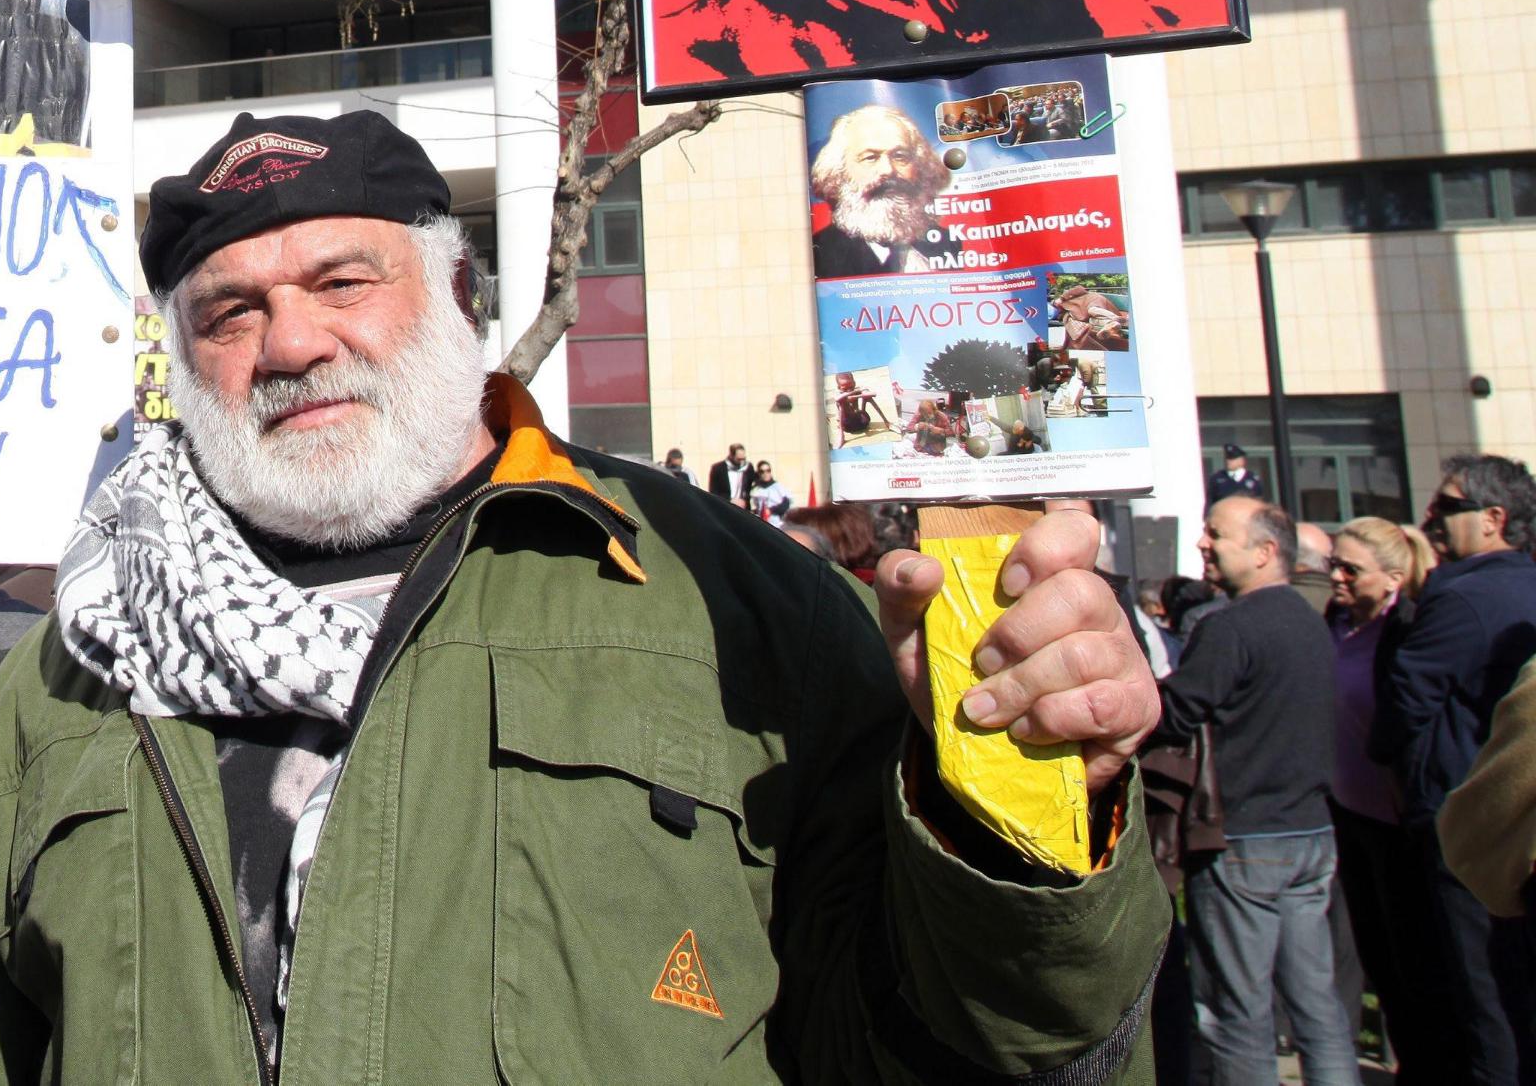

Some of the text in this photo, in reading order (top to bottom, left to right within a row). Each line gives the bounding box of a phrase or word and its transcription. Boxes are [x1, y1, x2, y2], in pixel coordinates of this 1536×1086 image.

[210, 136, 319, 186] CHRISTIAN BROTHERS
[925, 197, 991, 215] «Είναι
[926, 208, 1111, 243] ο Καπιταλισμός,
[929, 250, 1008, 269] ηλίθιε»
[1060, 248, 1114, 258] Ειδική έκδοση
[840, 298, 1039, 332] «ΔΙΑΛΟΓΟΣ»
